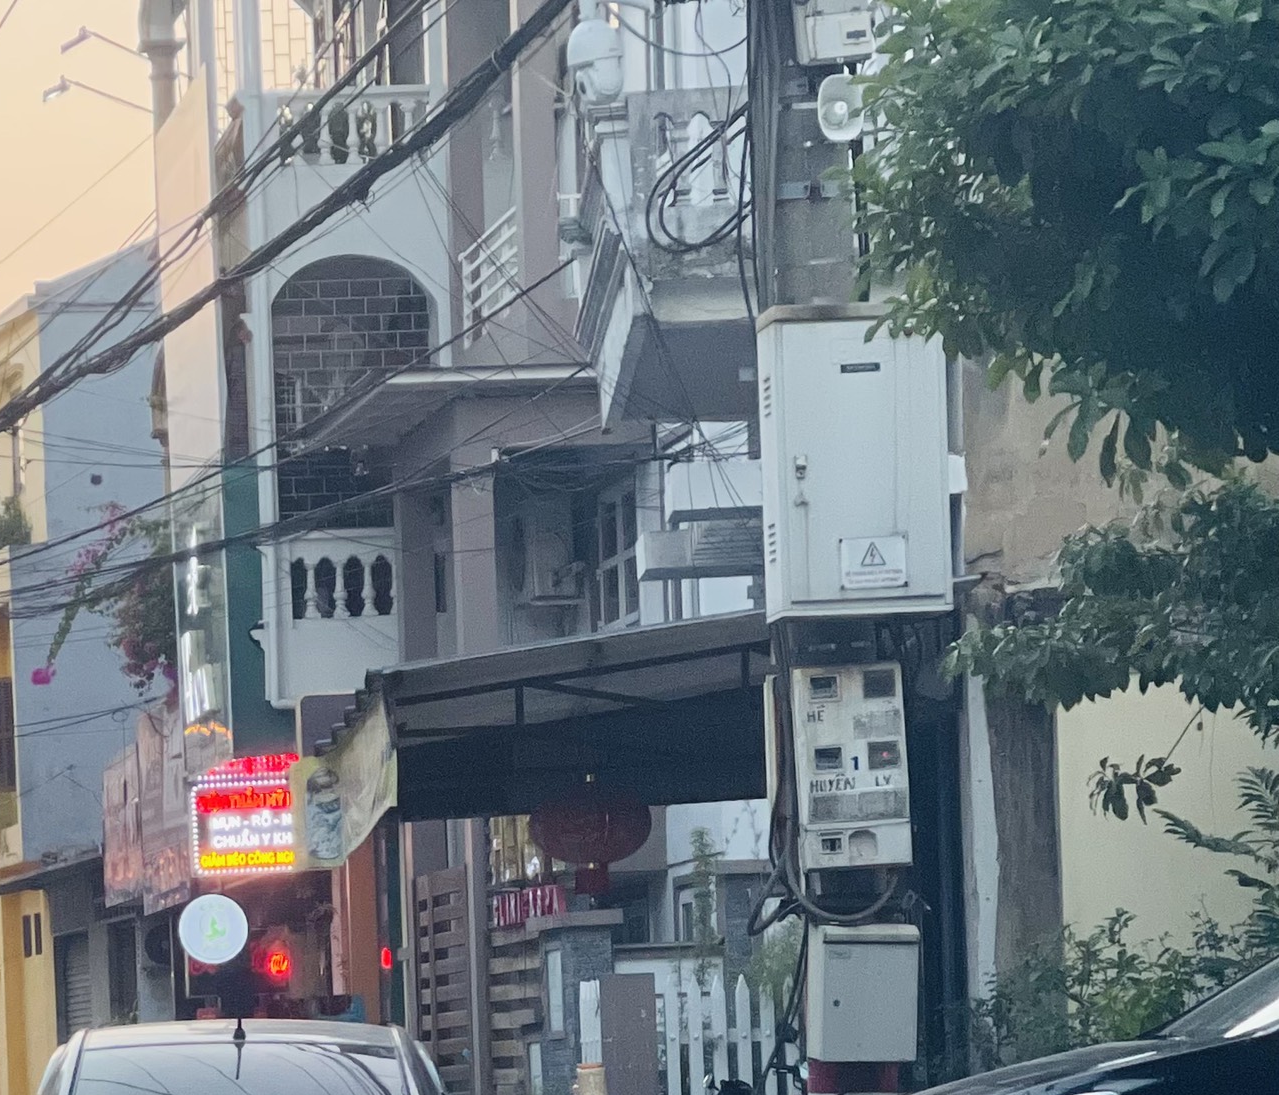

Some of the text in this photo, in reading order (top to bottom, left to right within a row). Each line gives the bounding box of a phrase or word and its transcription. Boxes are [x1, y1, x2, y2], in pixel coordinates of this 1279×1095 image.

[850, 755, 860, 771] 1
[212, 829, 260, 848] CHUẨN
[262, 833, 270, 846] Y
